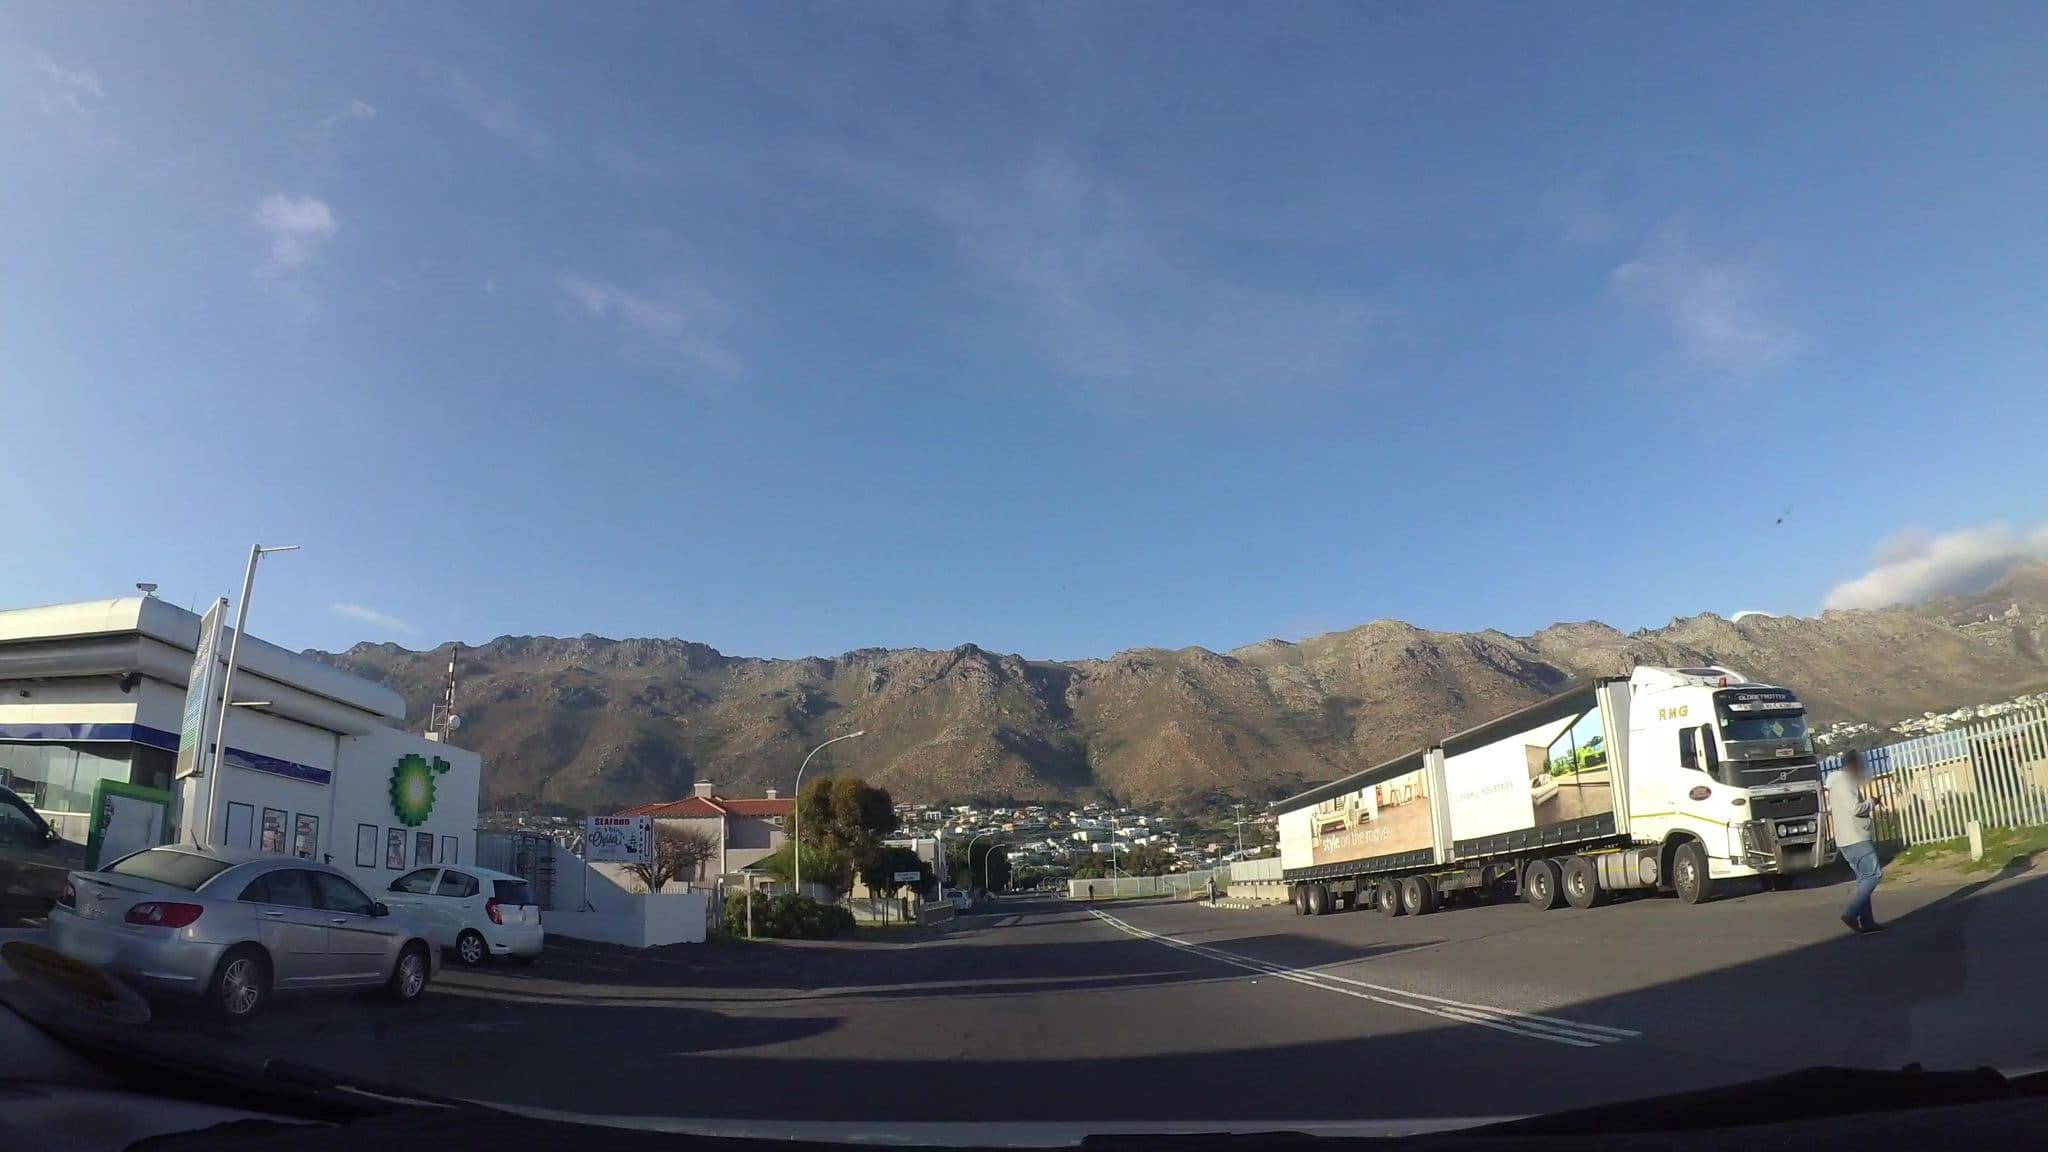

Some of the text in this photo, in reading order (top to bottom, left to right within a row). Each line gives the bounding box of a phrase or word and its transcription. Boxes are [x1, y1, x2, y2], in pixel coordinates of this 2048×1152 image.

[594, 818, 630, 826] SEAFOOD
[1323, 834, 1340, 853] style
[1341, 834, 1351, 847] on
[1352, 831, 1363, 845] the
[1365, 826, 1389, 843] move
